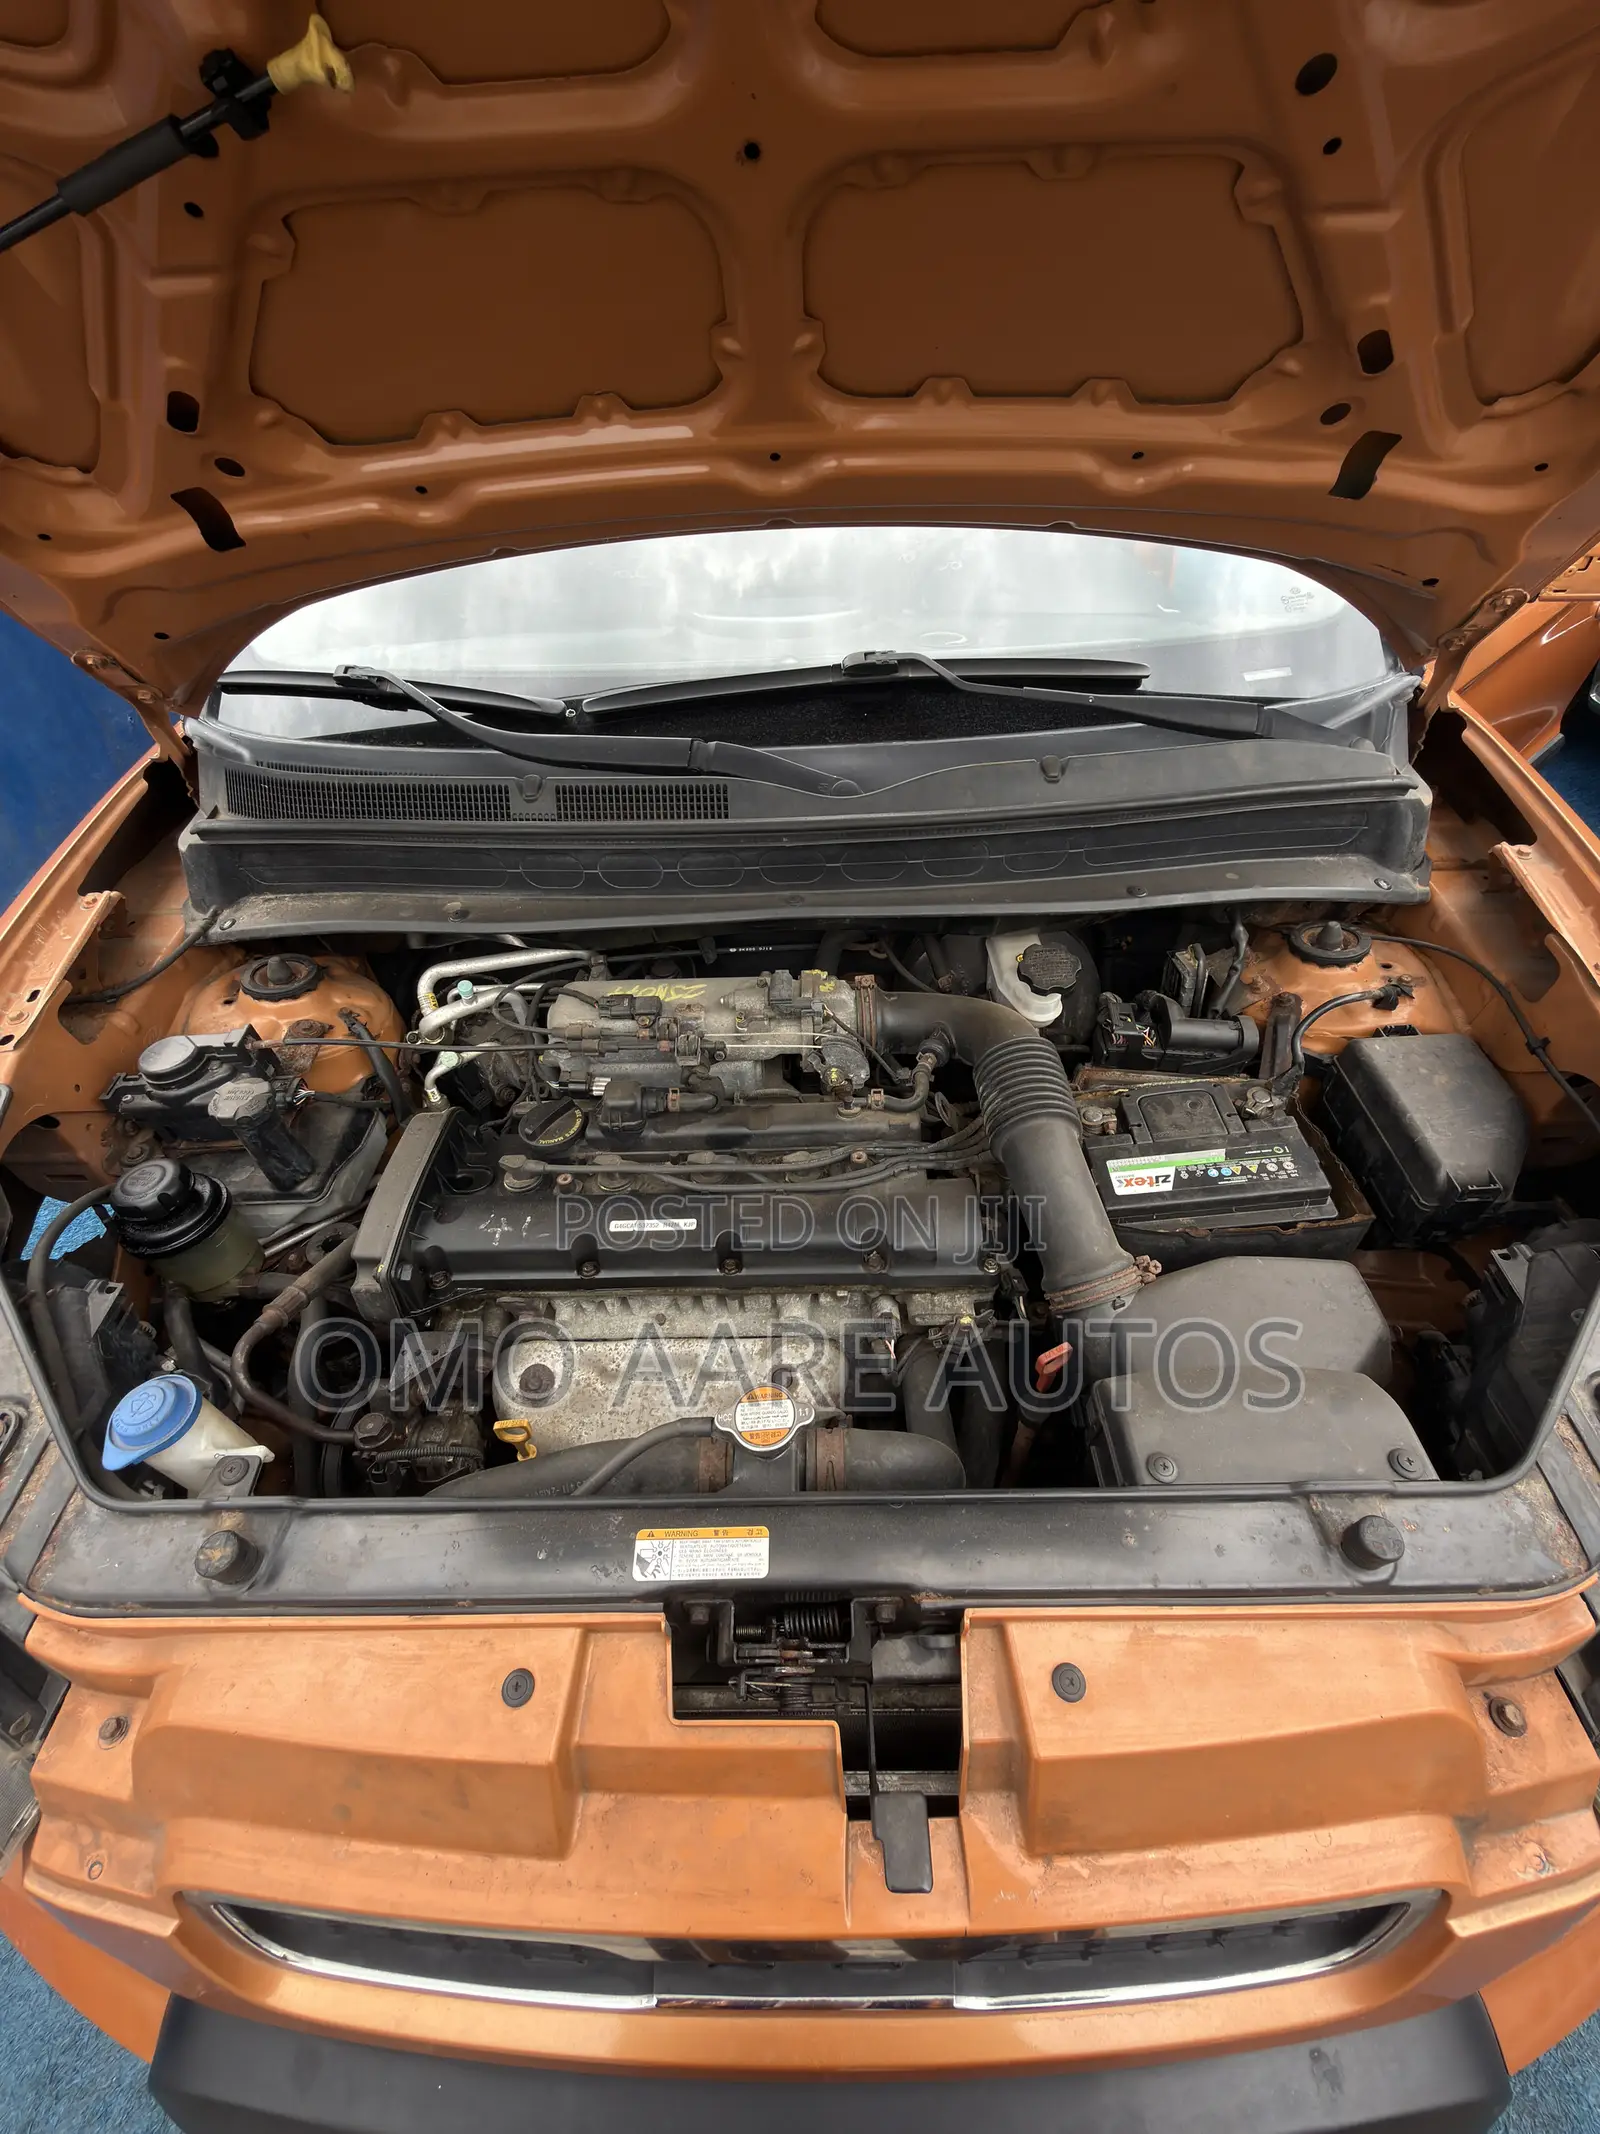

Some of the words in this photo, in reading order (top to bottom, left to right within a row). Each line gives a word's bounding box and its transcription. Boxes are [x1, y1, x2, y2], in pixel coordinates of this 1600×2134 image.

[1124, 1174, 1171, 1188] zitex
[798, 1407, 809, 1417] 1.1
[718, 1413, 733, 1421] HCC
[664, 1530, 699, 1538] WARNING
